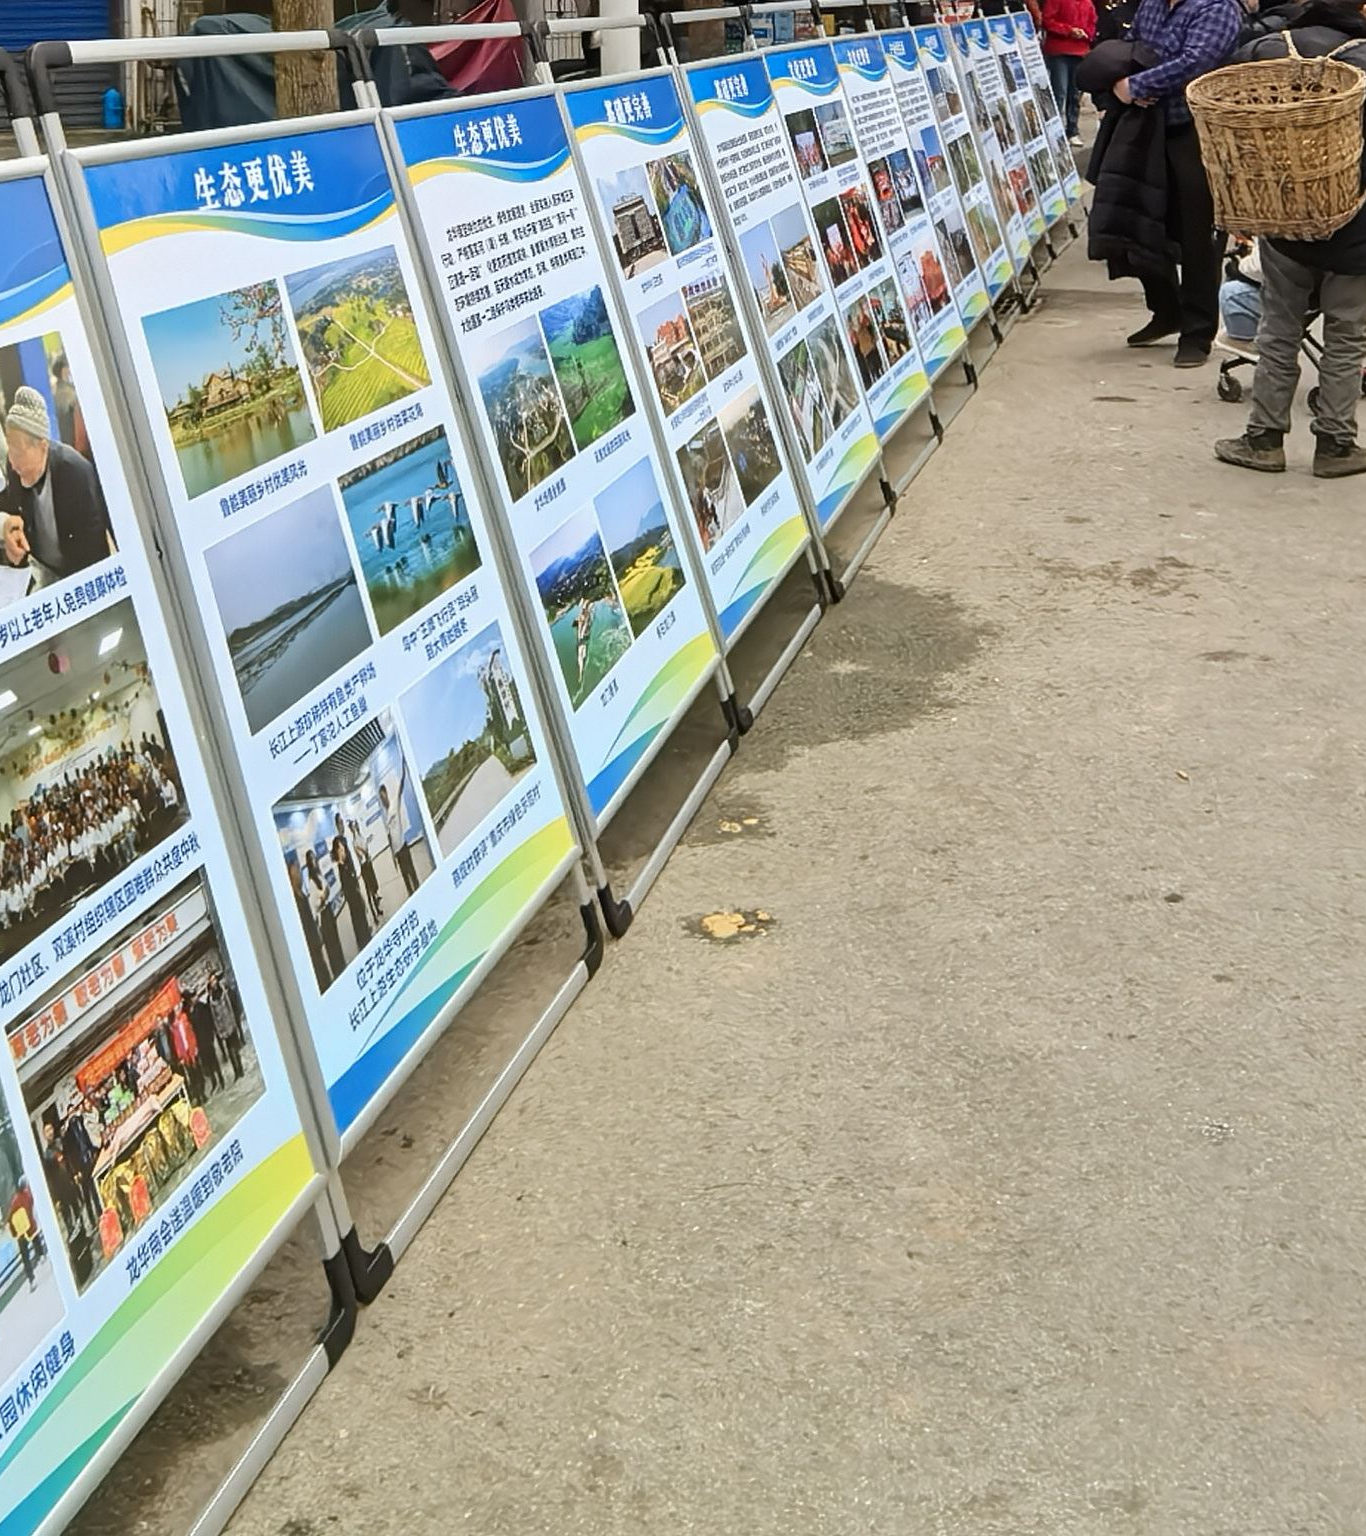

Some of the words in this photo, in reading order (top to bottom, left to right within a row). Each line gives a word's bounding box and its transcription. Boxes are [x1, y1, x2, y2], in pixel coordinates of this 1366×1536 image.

[453, 113, 524, 157] 生态更优美
[193, 150, 315, 212] 生态更优美
